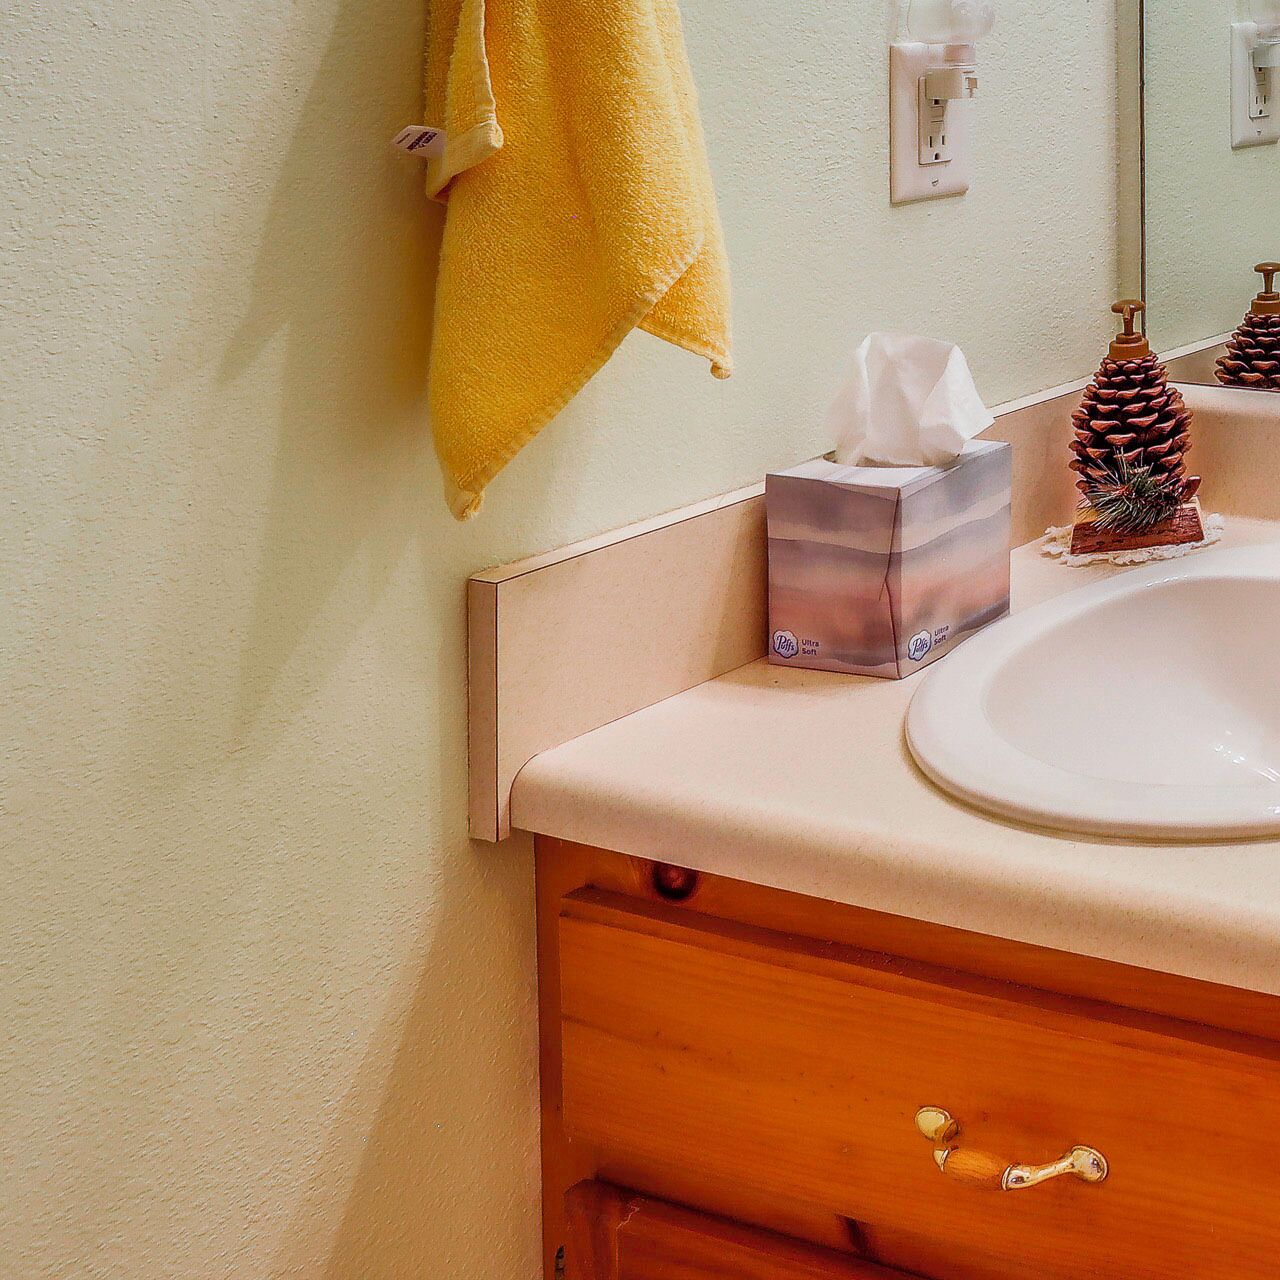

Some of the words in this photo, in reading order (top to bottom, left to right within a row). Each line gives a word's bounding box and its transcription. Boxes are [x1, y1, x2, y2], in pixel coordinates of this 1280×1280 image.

[776, 635, 795, 652] Puffs
[802, 639, 820, 647] Ultra
[802, 648, 817, 656] Soft
